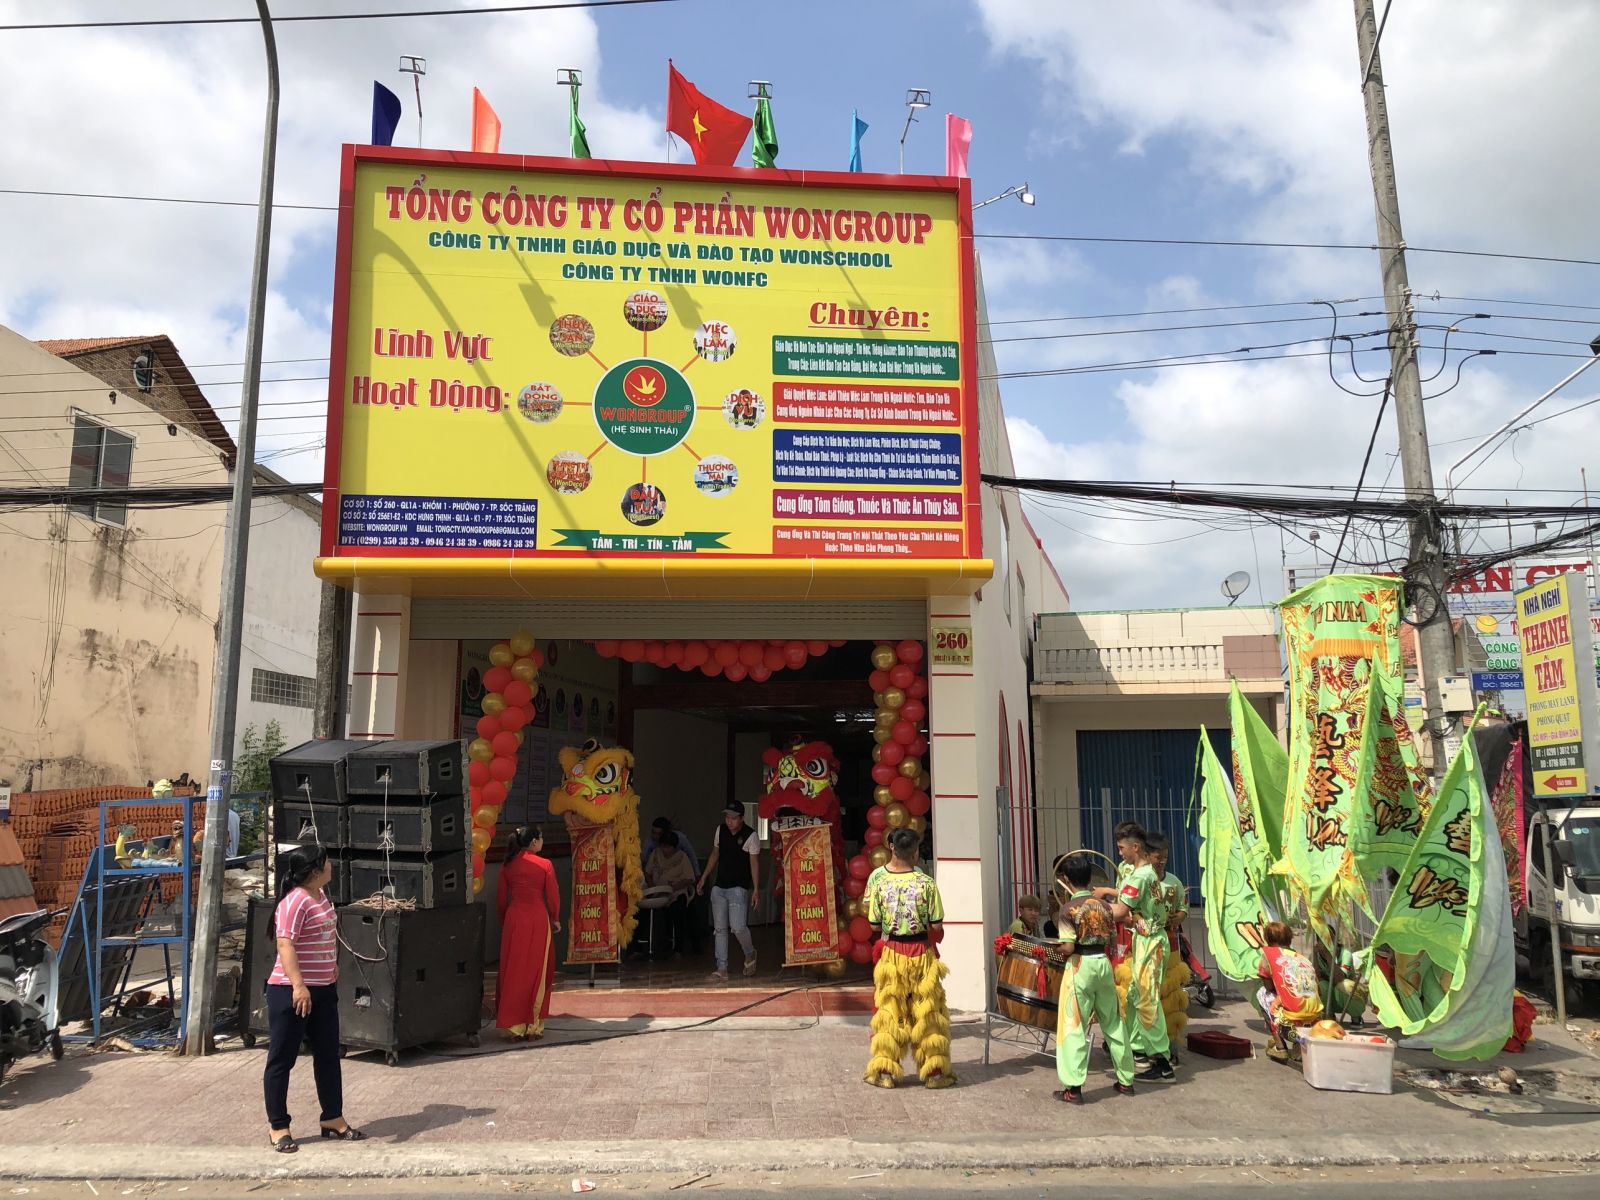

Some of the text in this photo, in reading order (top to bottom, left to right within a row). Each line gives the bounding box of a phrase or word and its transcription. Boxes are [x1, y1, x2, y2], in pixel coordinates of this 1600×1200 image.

[385, 174, 933, 244] TỔNG CÔNG TY CỔ PHẦN WONGROUP
[429, 231, 892, 268] CÔNG TY TNHH GIÁO DỤC VÀ ĐÀO TẠO WONSCHOOL
[562, 262, 768, 287] CÔNG TY TNHH WONFC
[634, 293, 658, 302] GIÁO
[809, 302, 930, 329] Chuyên:
[374, 328, 494, 364] Lĩnh Vực
[352, 376, 510, 413] Hoạt Động:
[600, 407, 687, 423] WONGROUP
[611, 425, 678, 436] (HỆ SINH THÁI)
[344, 499, 354, 507] CƠ
[356, 498, 364, 508] SỞ
[374, 498, 382, 508] SỐ
[401, 501, 417, 509] QL1A
[422, 500, 441, 510] KHÓM
[453, 501, 479, 511] PHƯỜNG
[500, 502, 513, 511] SÓC
[777, 496, 796, 514] Cung
[798, 494, 813, 514] Ứng
[814, 496, 830, 513] Tôm
[832, 495, 855, 515] Giống,
[857, 496, 880, 514] Thuốc
[881, 497, 891, 514] Và
[893, 498, 911, 514] Thức
[912, 496, 922, 514] Ăn
[924, 498, 941, 516] Thủy
[343, 511, 352, 519] CƠ
[353, 509, 361, 519] SỞ
[369, 509, 376, 519] SỐ
[418, 512, 433, 521] HƯNG
[435, 514, 451, 523] THỊNH
[456, 514, 469, 522] QL1A
[504, 514, 515, 523] SÓC
[367, 524, 407, 532] WONGROUP.VN
[357, 537, 381, 545] (0299)
[425, 538, 443, 546] 0946
[468, 539, 476, 547] 39
[483, 539, 501, 547] 0986
[592, 536, 612, 549] TÂM
[622, 537, 637, 550] TRÍ
[647, 537, 663, 550] TÍN
[1523, 582, 1561, 617] NHÀ NGHỈ
[1325, 601, 1368, 622] NAM
[936, 632, 968, 649] 260
[1522, 614, 1571, 654] THANH
[1485, 641, 1518, 653] CÔNG
[1487, 657, 1518, 669] CÔNG
[1534, 655, 1566, 693] TÂM
[581, 859, 601, 873] KHAI
[800, 856, 814, 873] MÃ
[575, 882, 607, 896] TRƯƠNG
[799, 880, 818, 896] ĐÁO
[580, 904, 602, 919] HỒNG
[796, 904, 824, 920] THÀNH
[580, 928, 602, 943] PHÁT
[801, 926, 822, 944] CÔNG
